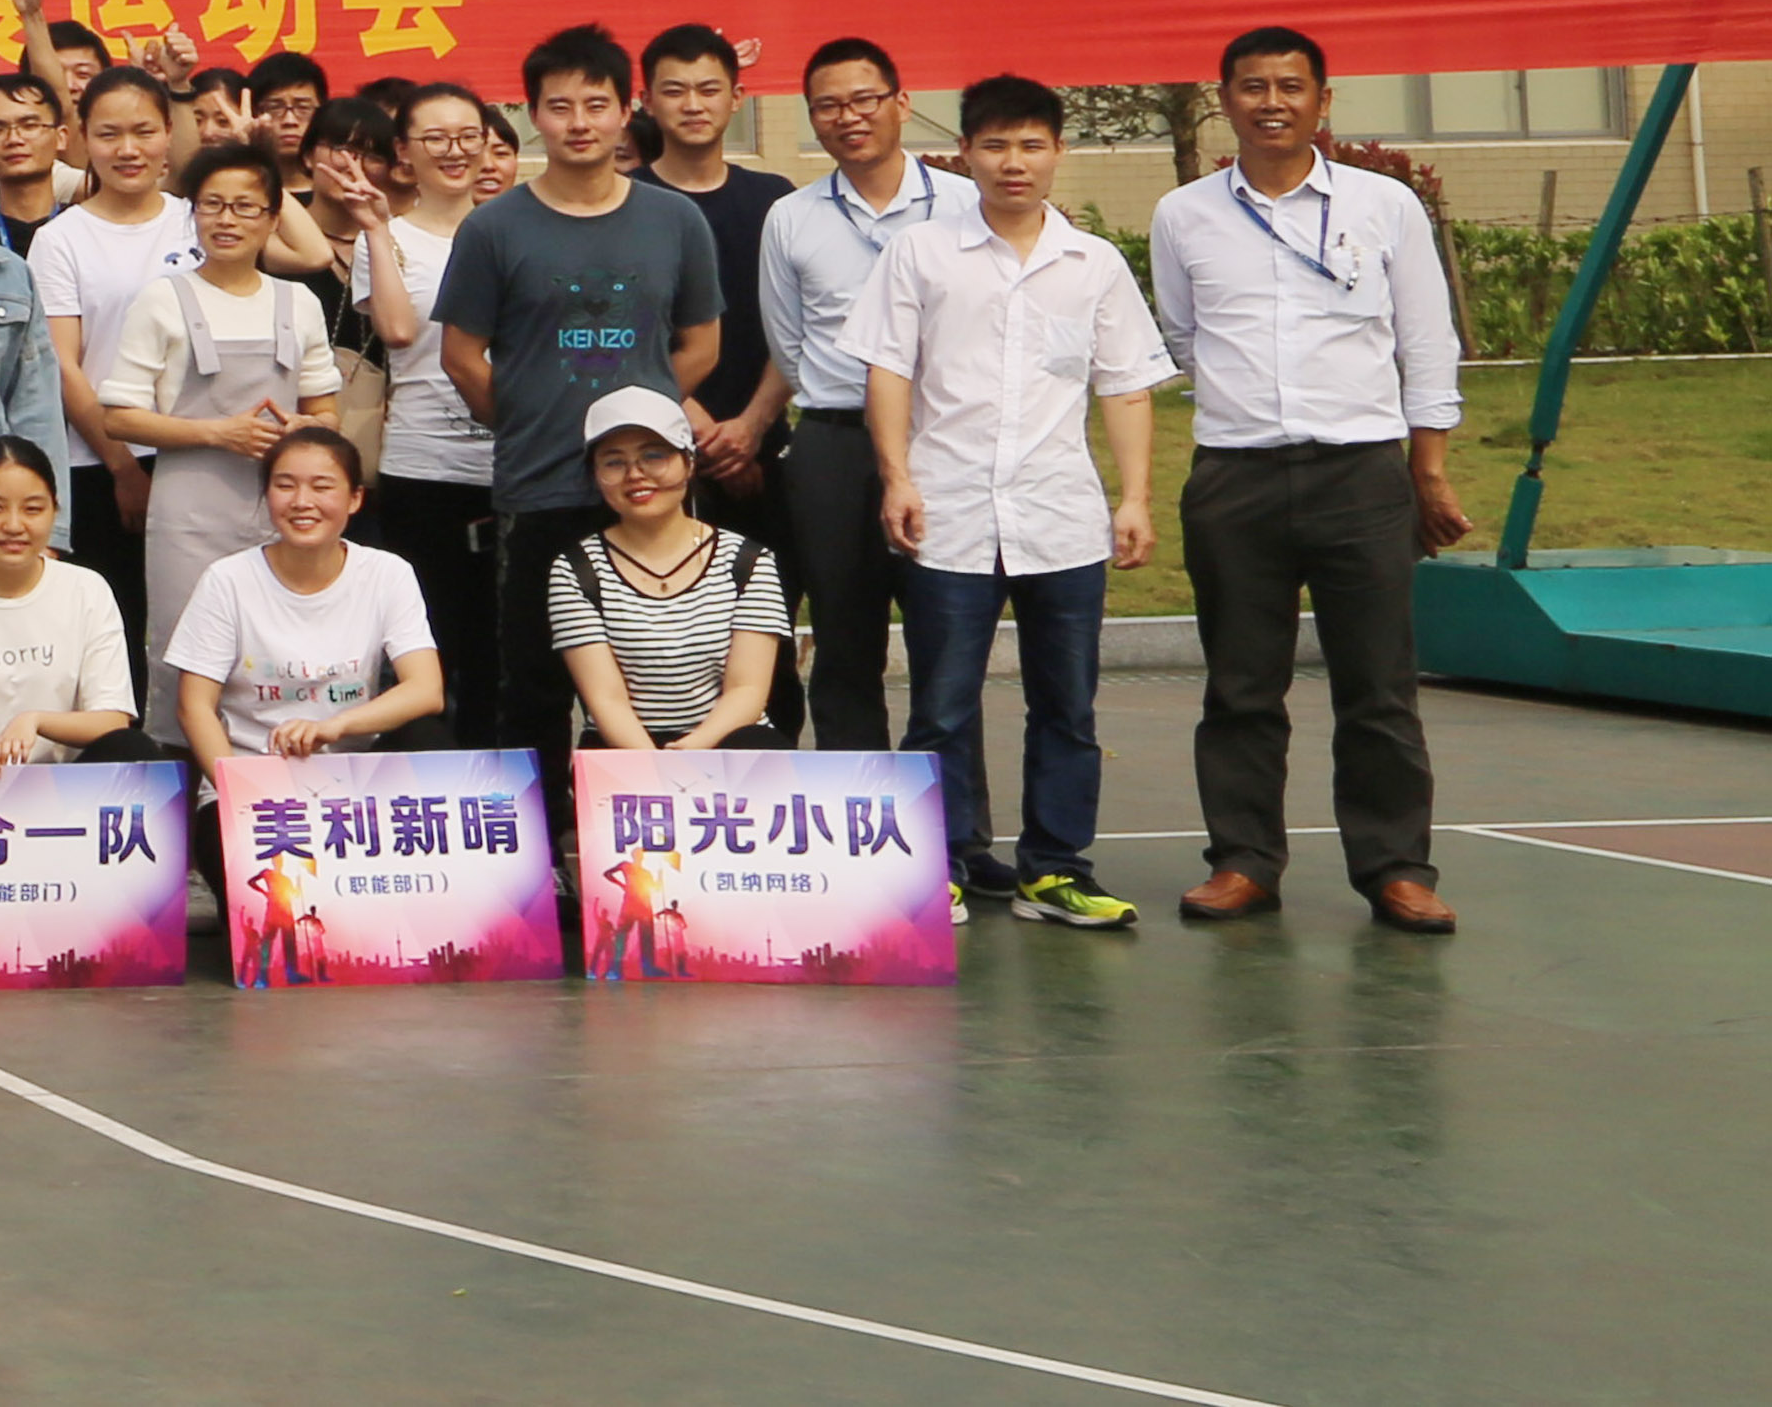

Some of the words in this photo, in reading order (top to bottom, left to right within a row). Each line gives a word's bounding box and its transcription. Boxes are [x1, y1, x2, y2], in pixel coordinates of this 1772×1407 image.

[558, 328, 636, 349] KENZO
[251, 792, 519, 860] 美利新晴
[611, 793, 912, 856] 阳光小队
[334, 871, 448, 896] （职能部门）
